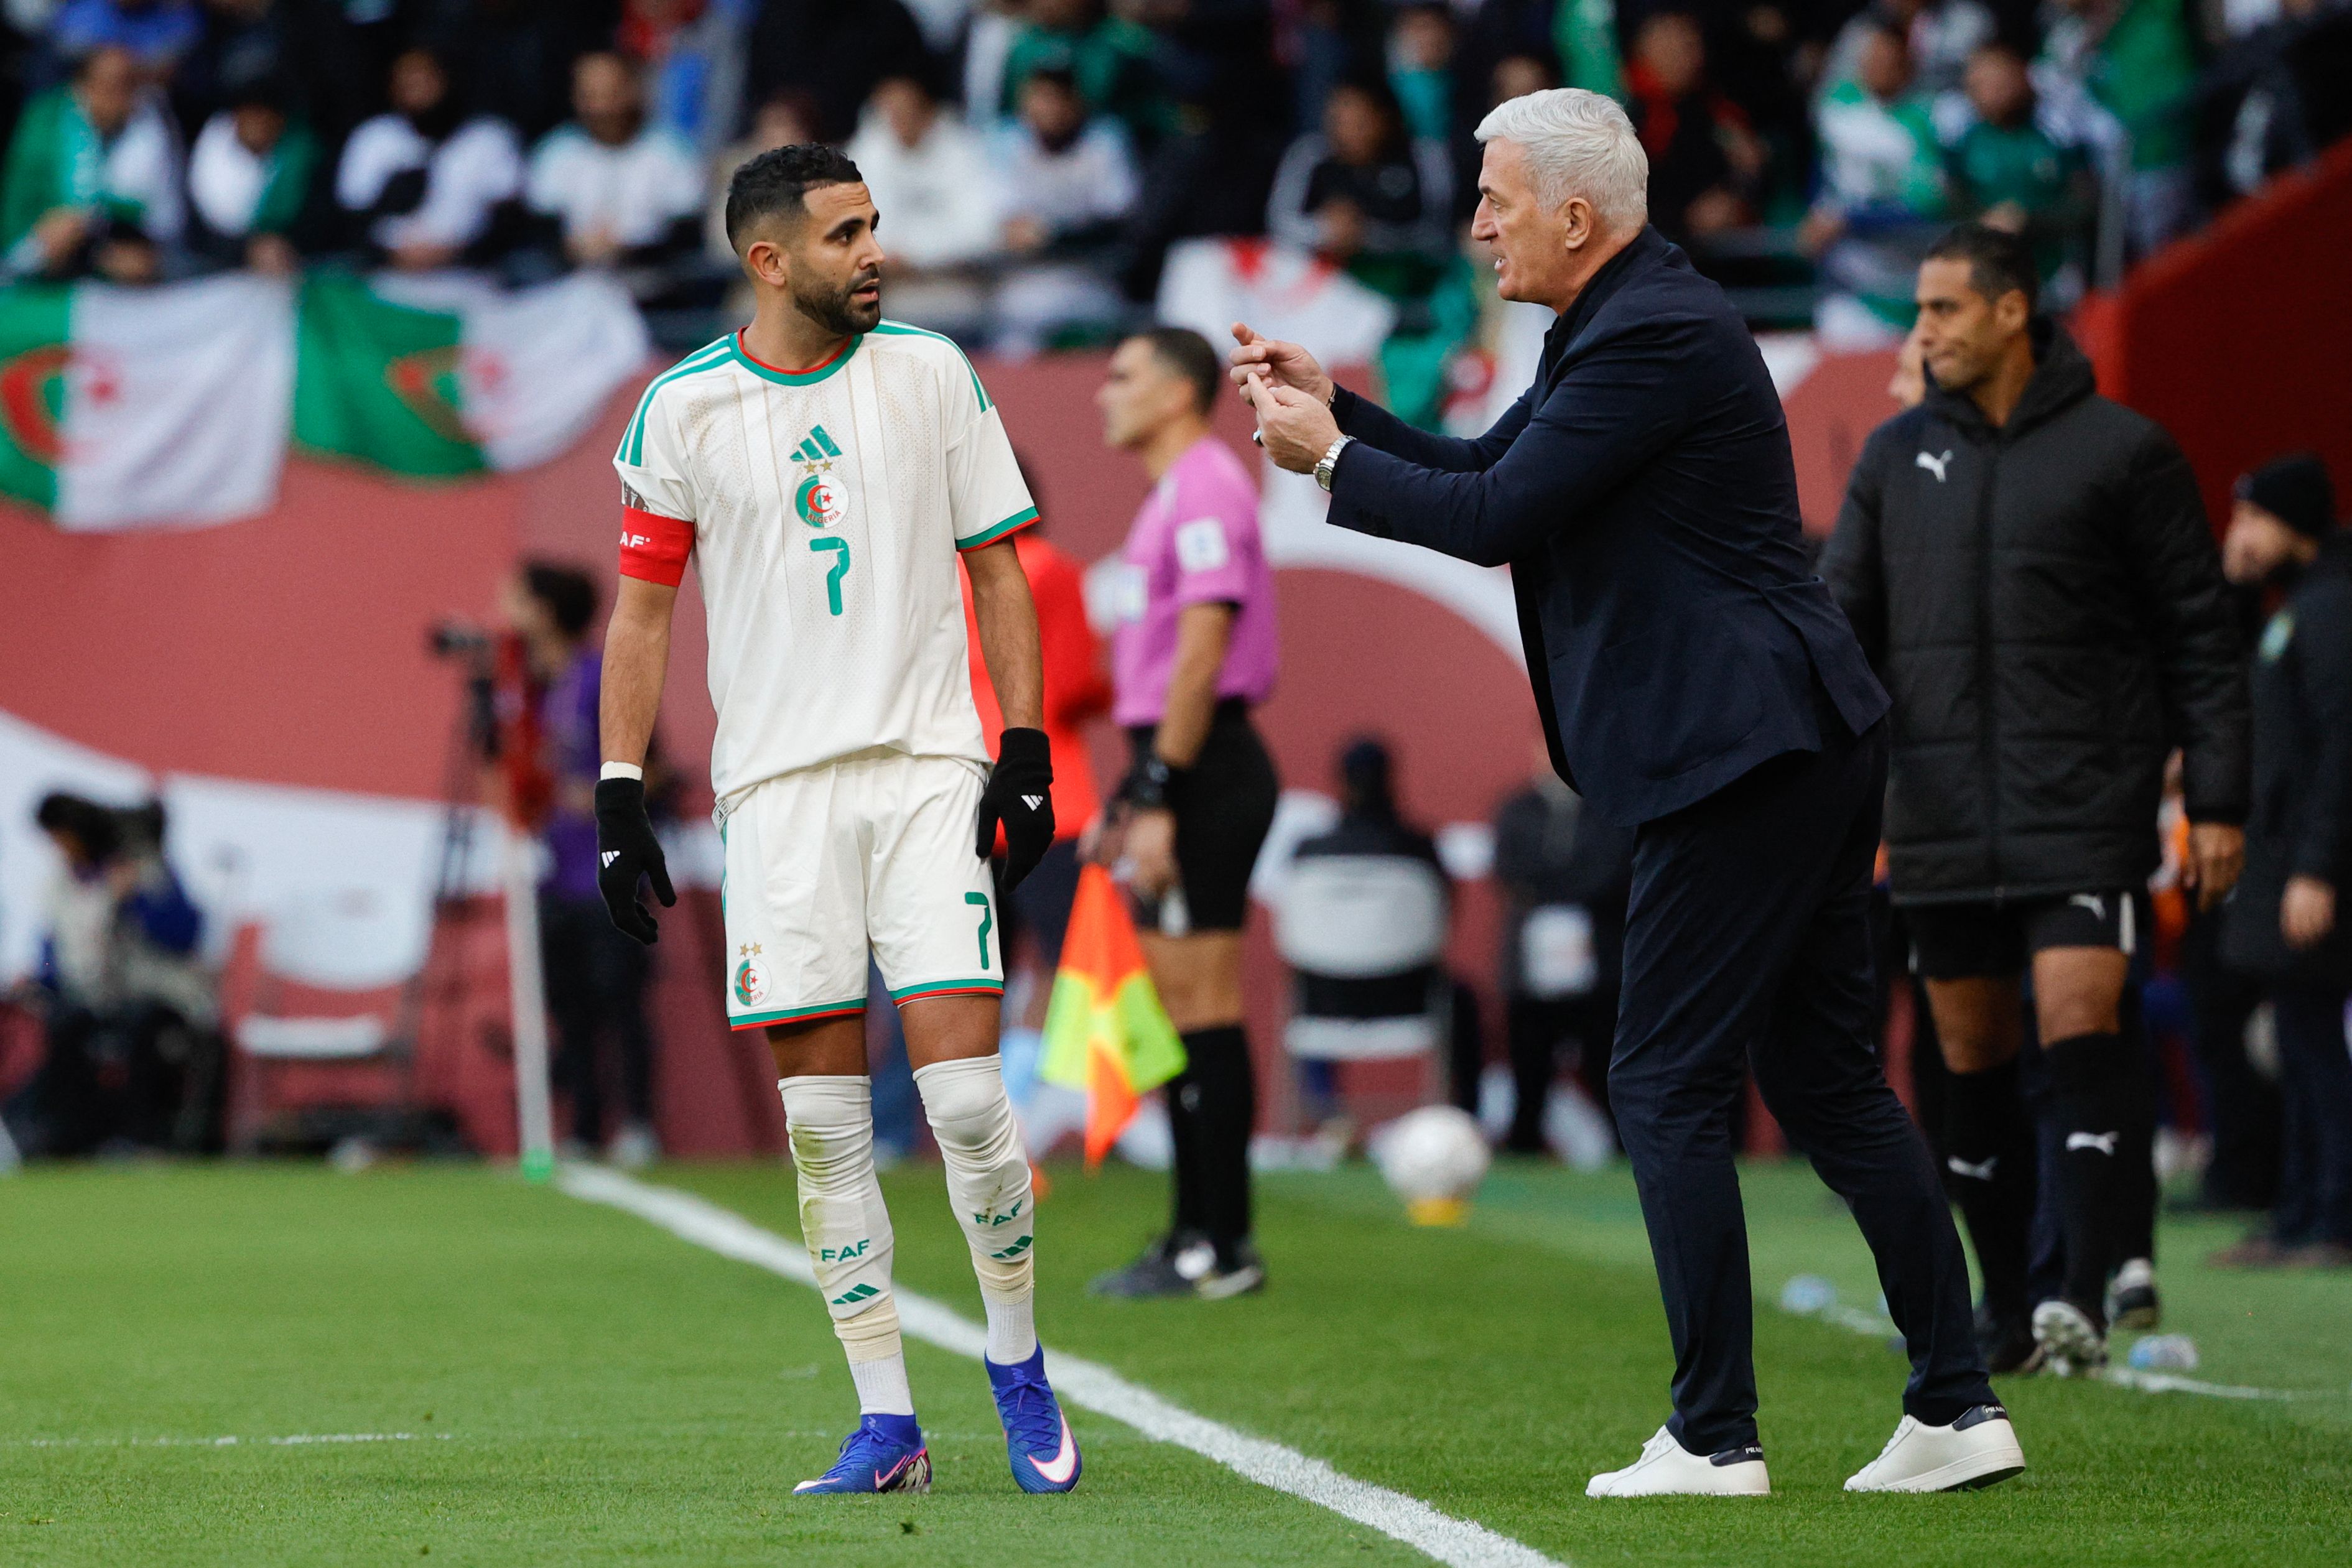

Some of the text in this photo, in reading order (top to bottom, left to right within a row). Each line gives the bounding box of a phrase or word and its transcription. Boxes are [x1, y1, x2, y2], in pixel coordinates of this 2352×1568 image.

[807, 510, 841, 524] ALGERIA
[809, 537, 850, 616] 7
[965, 892, 992, 970] 7
[975, 1199, 1023, 1227] FAF
[821, 1239, 870, 1262] FAF
